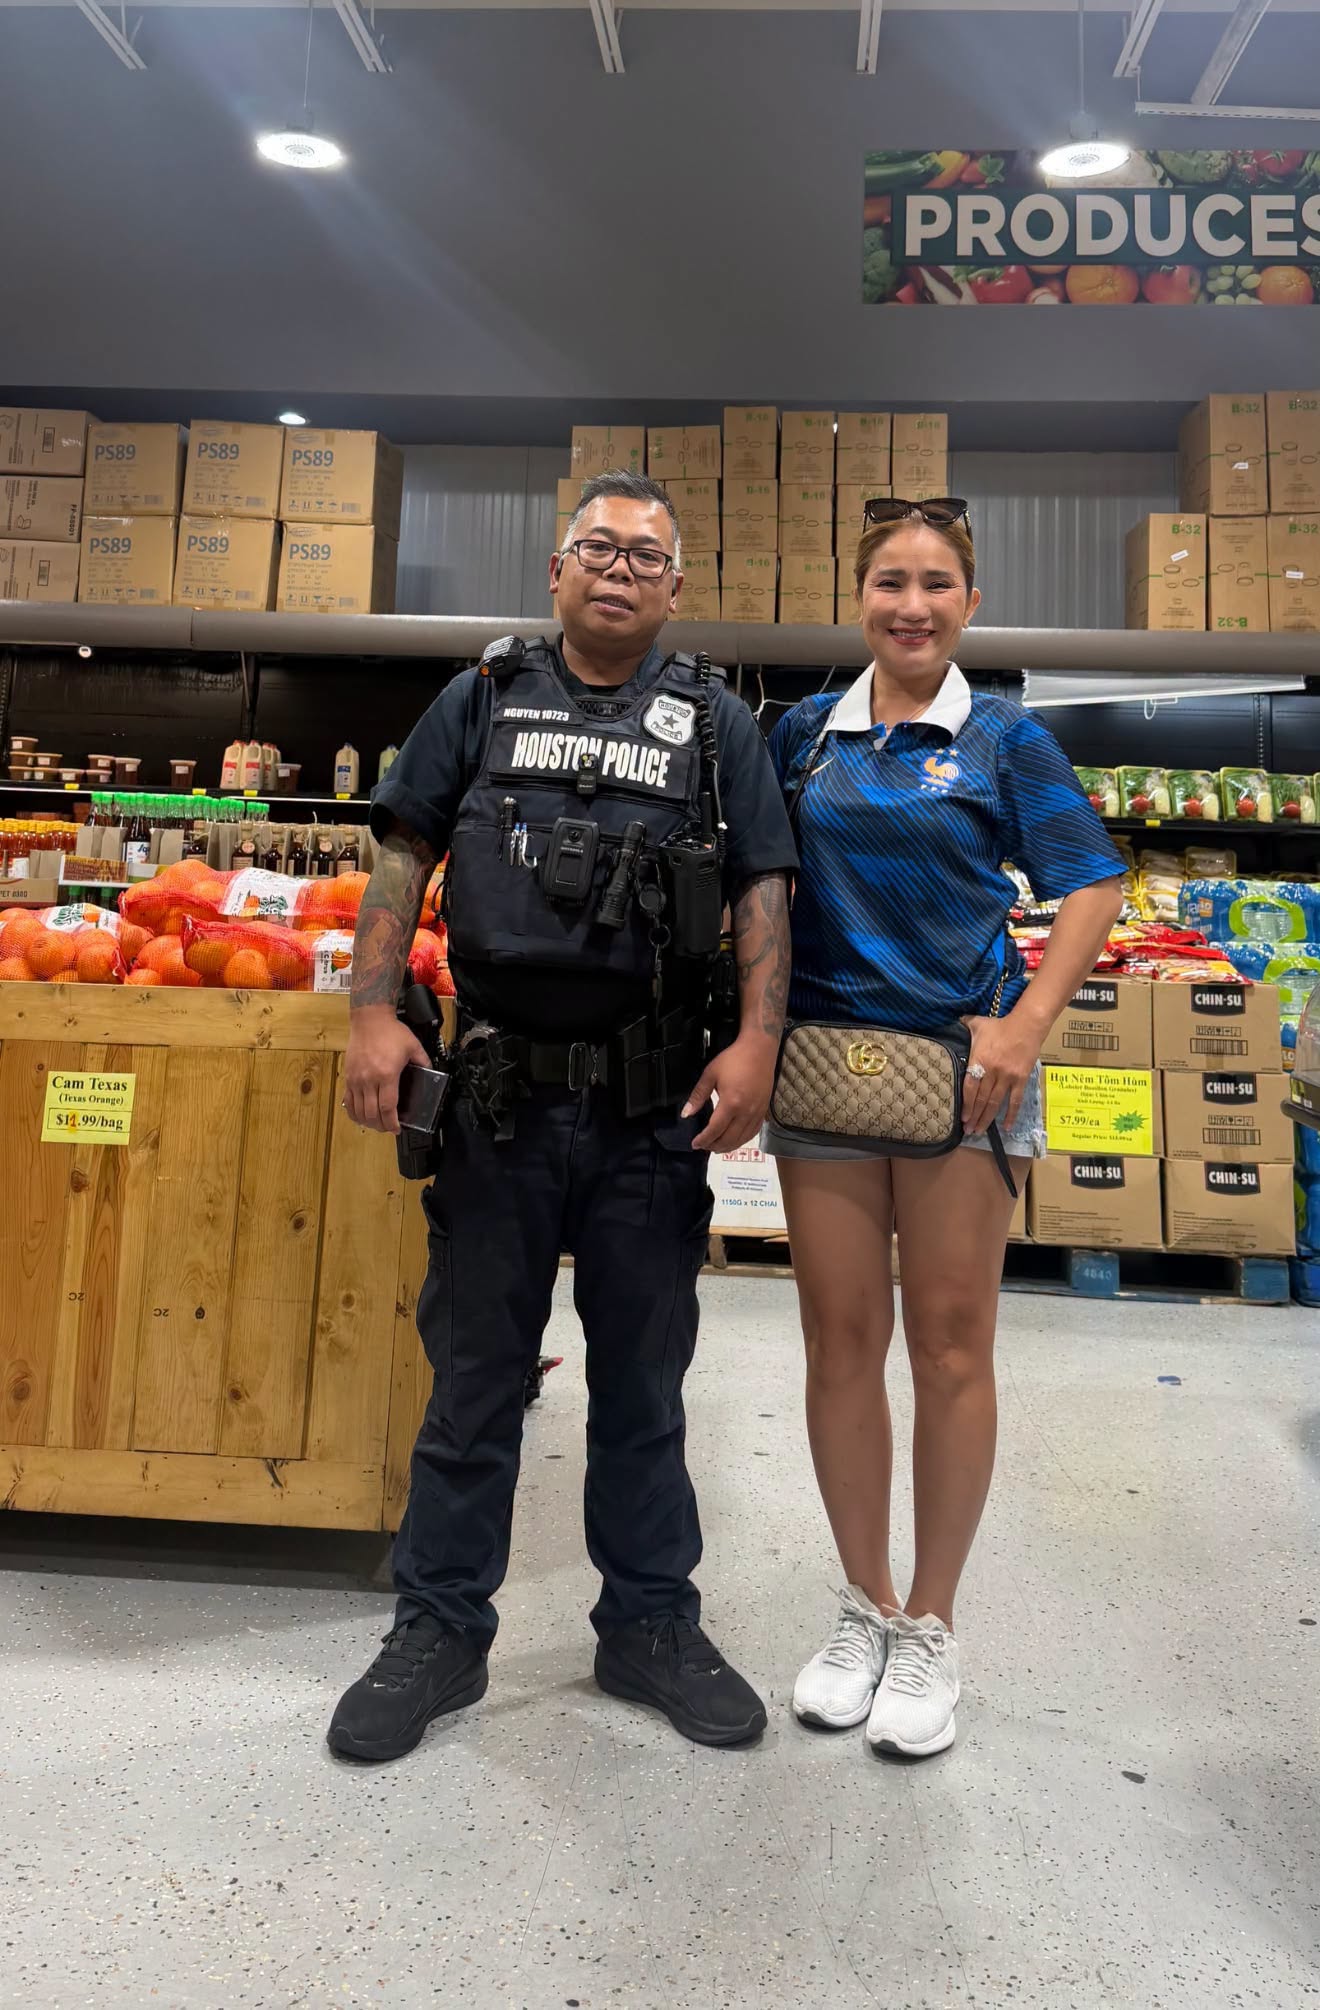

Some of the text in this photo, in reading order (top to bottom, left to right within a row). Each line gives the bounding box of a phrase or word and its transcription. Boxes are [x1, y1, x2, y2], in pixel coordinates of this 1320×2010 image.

[1232, 404, 1260, 413] B-32
[1289, 401, 1318, 410] B-32
[95, 444, 136, 461] PS89
[198, 442, 240, 460] PS89
[292, 450, 334, 467] PS89
[1171, 524, 1201, 535] B-32
[1289, 524, 1318, 534] B-32
[89, 537, 132, 554] PS89
[187, 535, 230, 553] PS89
[289, 543, 331, 560] PS89
[1217, 616, 1248, 628] B-32
[503, 708, 569, 721] NGUYEN 10723
[511, 732, 671, 788] HOUSTON POLICE
[1072, 989, 1115, 1001] HIN-SU
[52, 1075, 128, 1091] Cam Texas
[59, 1093, 124, 1106] (Texas Orange)
[1060, 1114, 1100, 1126] $7.99/ea
[153, 1308, 169, 1317] 2C
